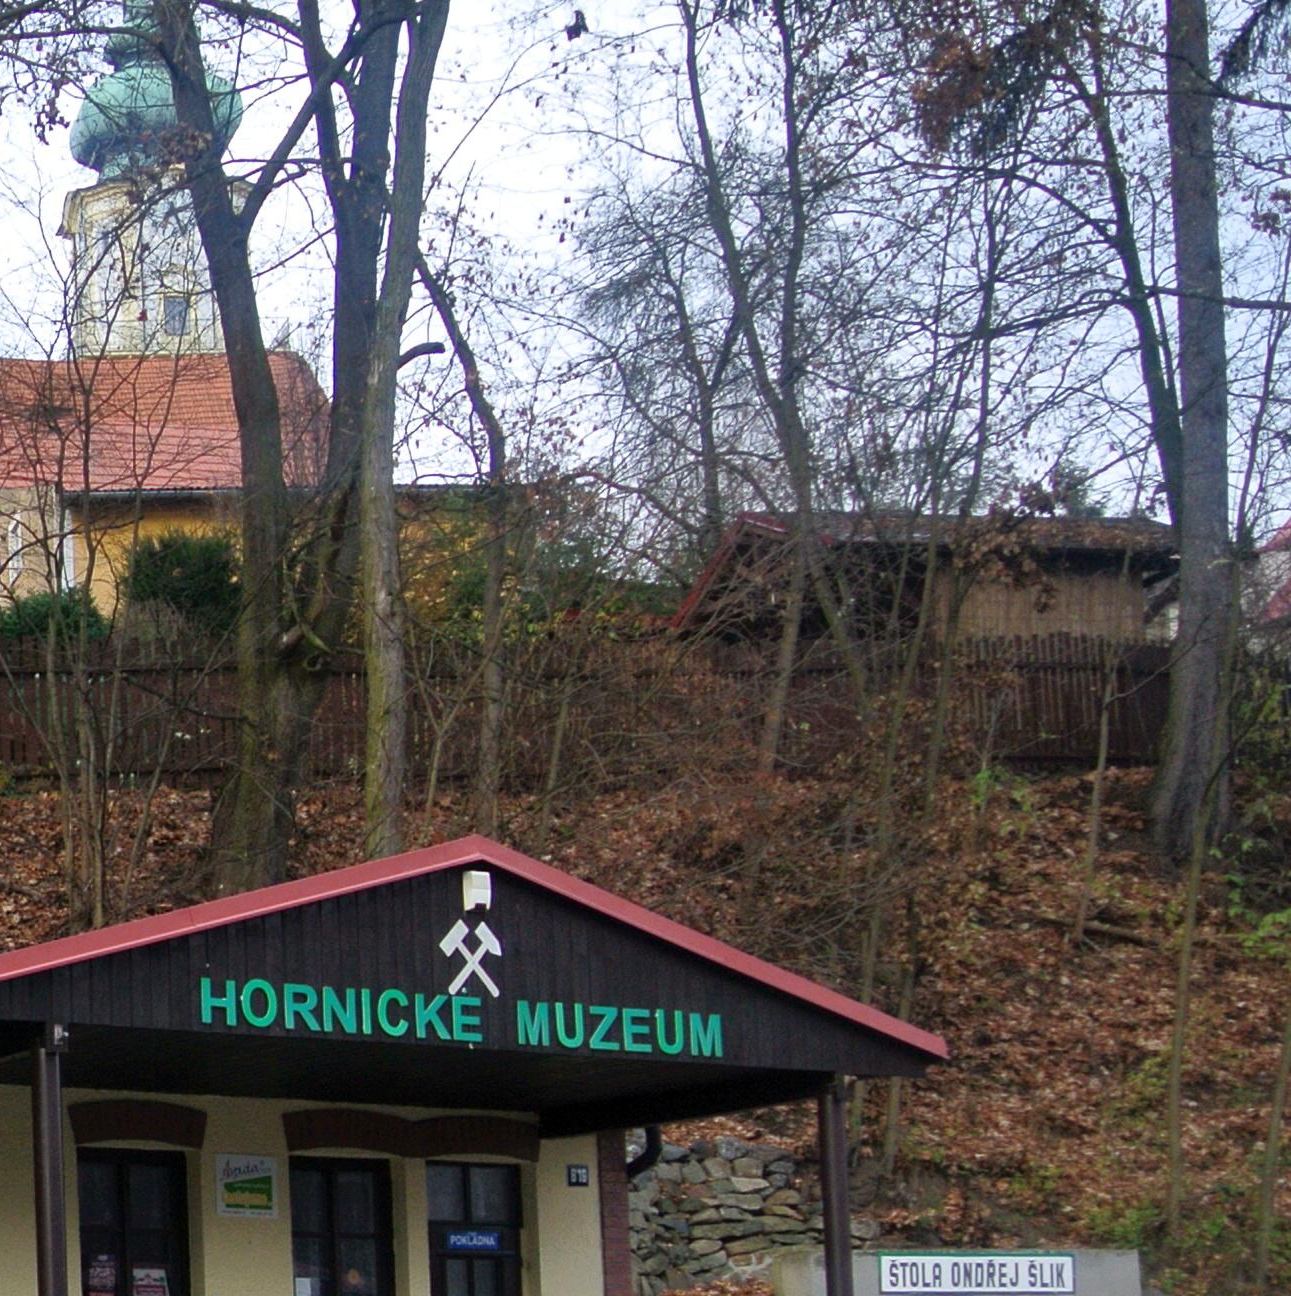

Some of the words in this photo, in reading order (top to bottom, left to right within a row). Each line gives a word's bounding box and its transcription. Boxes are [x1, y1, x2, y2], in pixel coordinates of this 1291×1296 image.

[516, 999, 724, 1058] MUZEUM
[450, 1235, 496, 1246] POKLADNA
[889, 1259, 942, 1288] ŠTOLA
[951, 1259, 1020, 1288] ONDŘEJ
[1028, 1259, 1066, 1288] ŠLIK
